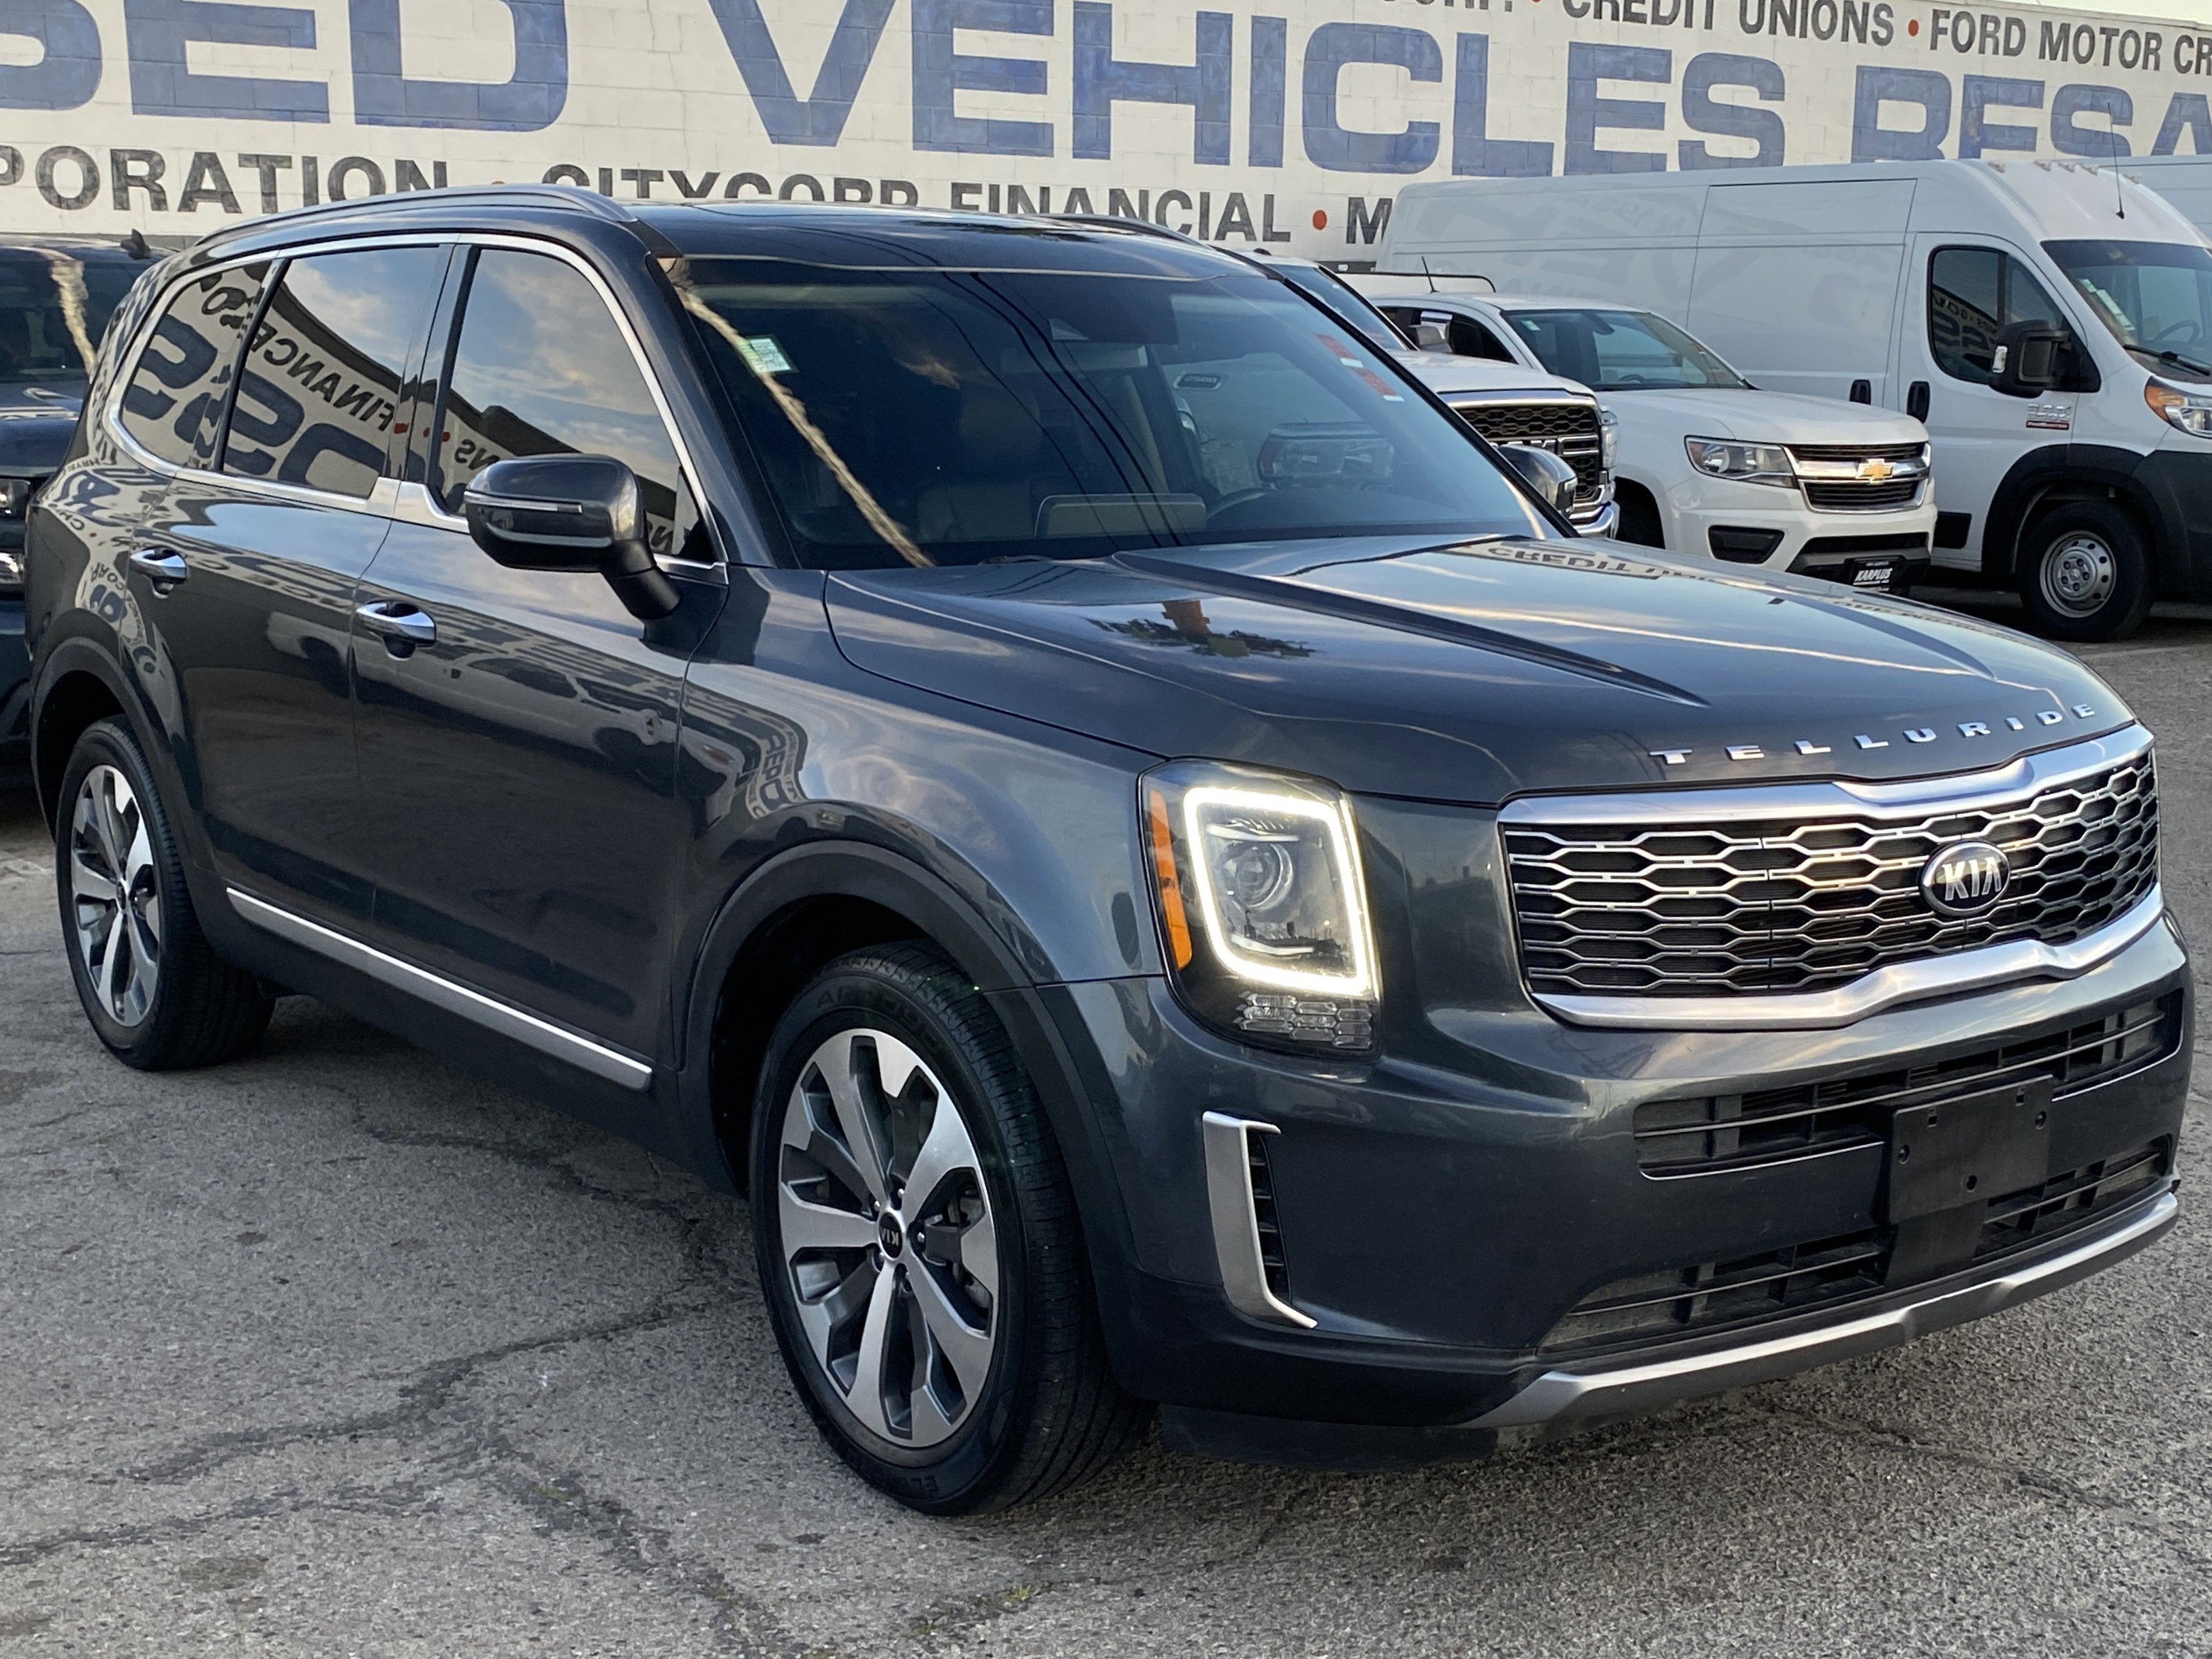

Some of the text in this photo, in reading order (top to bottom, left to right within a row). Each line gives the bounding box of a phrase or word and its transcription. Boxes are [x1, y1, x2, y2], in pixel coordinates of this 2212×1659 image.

[1739, 0, 1894, 46] UNIONS
[1930, 9, 2212, 76] FORD MOTOR CR
[708, 0, 1785, 176] VEHICLES
[951, 182, 1291, 242] FINANCIAL
[1649, 704, 2096, 765] TELLURIDE
[1941, 857, 2002, 900] KIA
[880, 1226, 900, 1246] KIA
